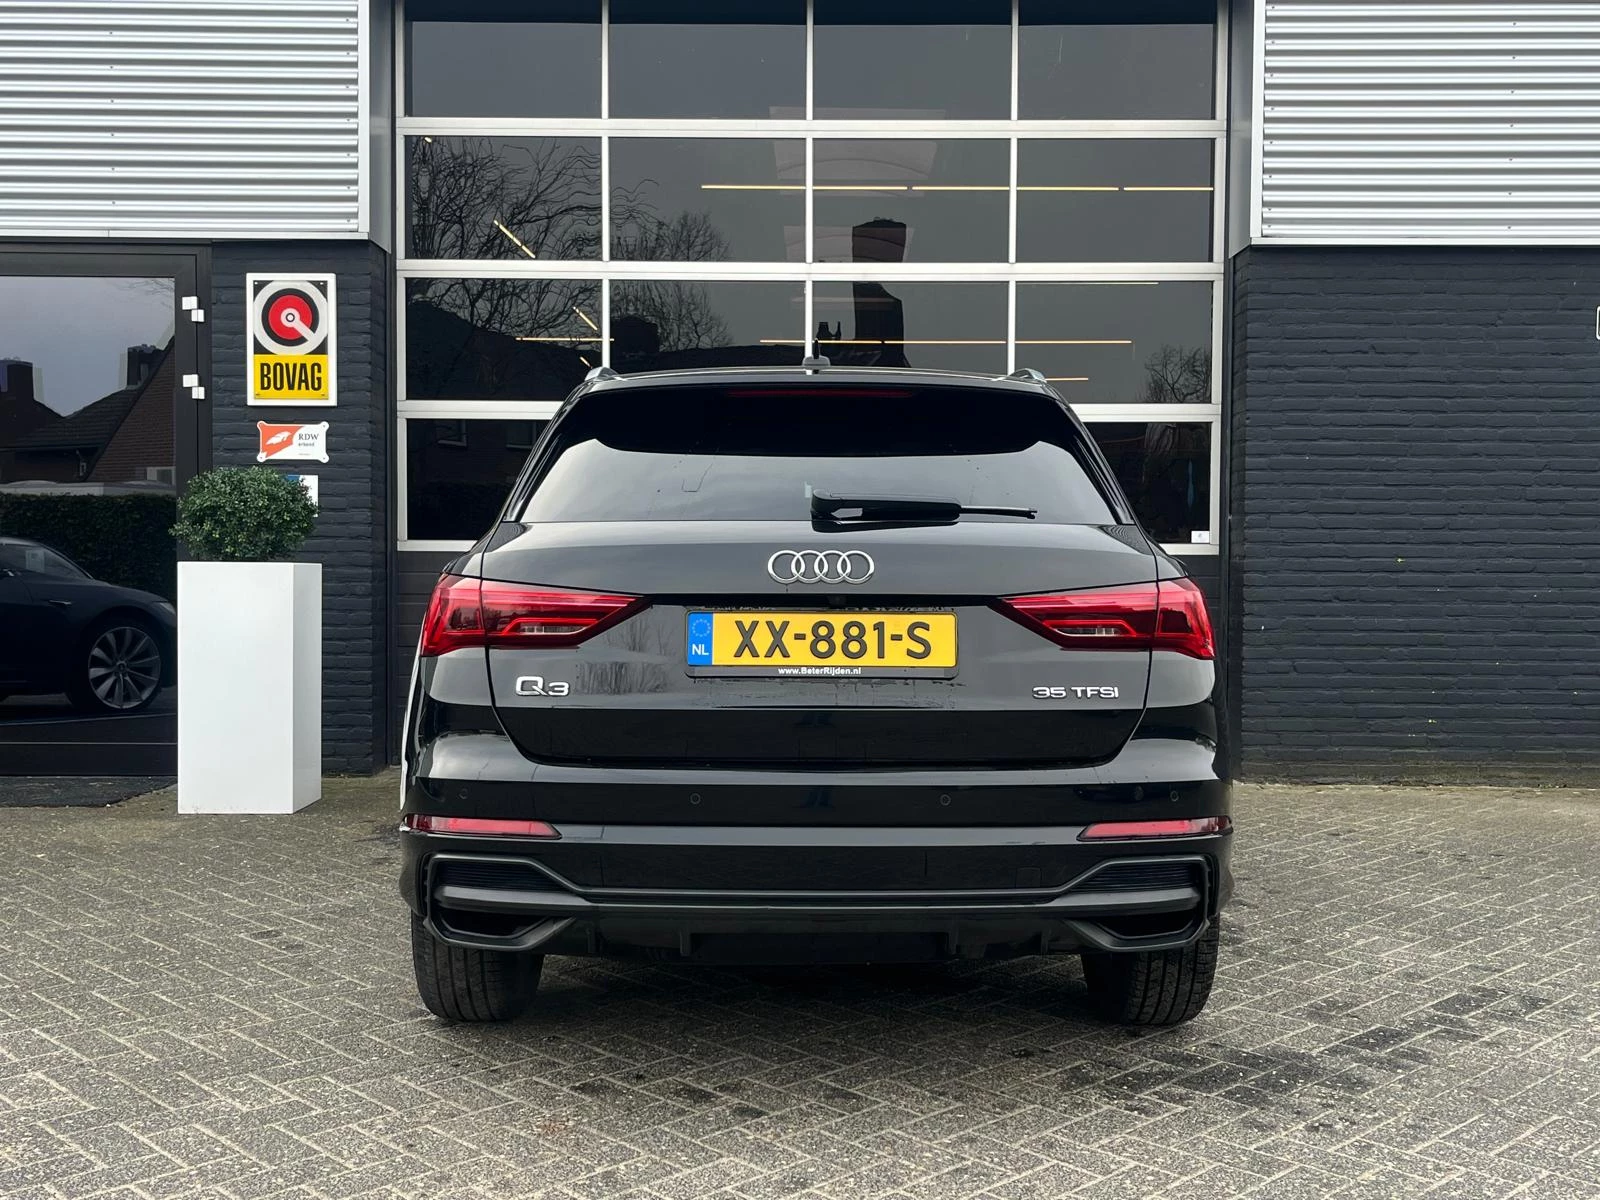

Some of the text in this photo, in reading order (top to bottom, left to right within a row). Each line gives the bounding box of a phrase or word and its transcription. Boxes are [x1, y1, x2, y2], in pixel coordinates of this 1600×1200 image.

[260, 362, 322, 391] BOVAG
[298, 433, 319, 441] RDW
[733, 620, 932, 660] XX-881-S
[691, 644, 709, 656] NL
[778, 667, 862, 676] www.BeterRijden.nl
[515, 676, 570, 697] Q3
[1032, 686, 1120, 699] 35 TFSI
